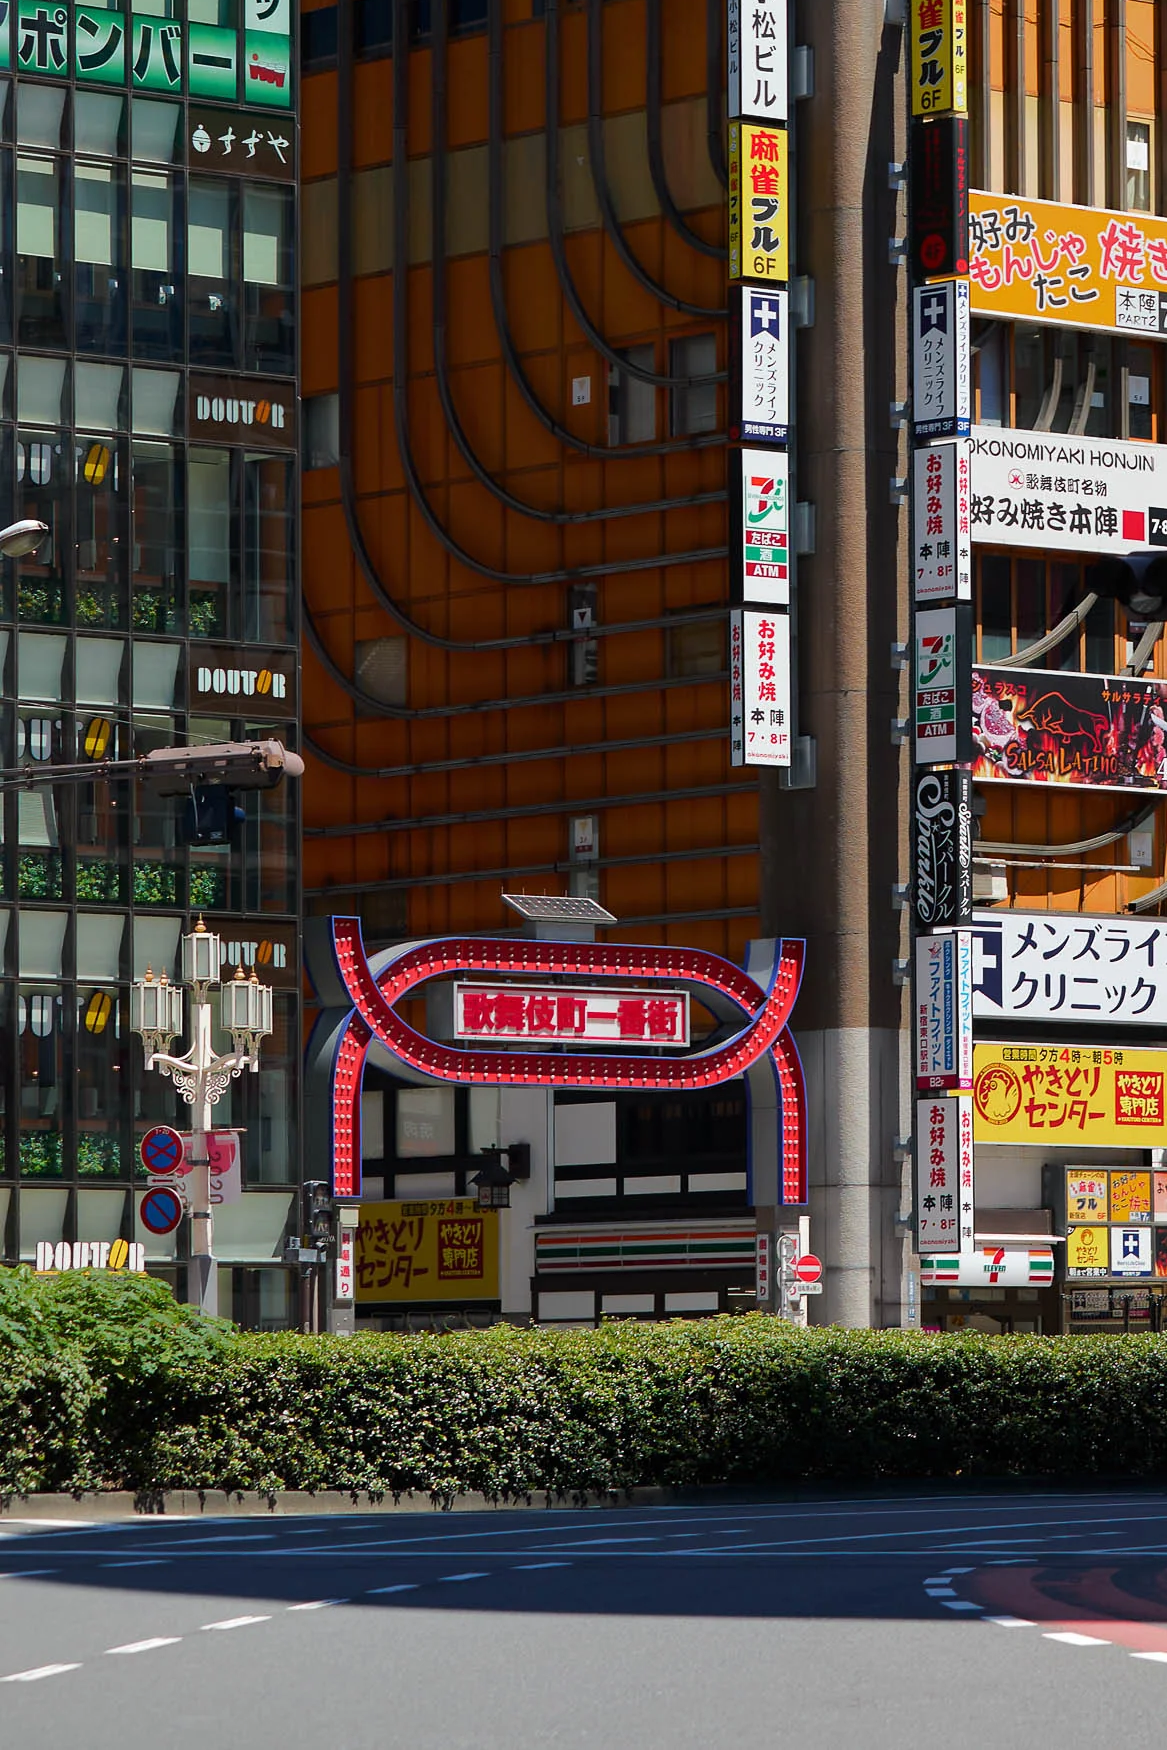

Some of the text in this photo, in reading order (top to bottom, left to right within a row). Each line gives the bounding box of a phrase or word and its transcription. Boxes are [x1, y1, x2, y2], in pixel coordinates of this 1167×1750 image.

[921, 89, 942, 110] 6F
[218, 126, 290, 164] すずや
[729, 158, 740, 225] 麻雀ブル
[749, 129, 781, 254] 麻雀ブル
[753, 255, 777, 276] 6F
[970, 231, 1087, 290] もんじゃ
[1032, 264, 1100, 311] たこ
[1119, 292, 1158, 313] 本陣
[1117, 312, 1158, 327] PART2
[753, 341, 765, 407] クリニック
[922, 338, 934, 406] クリニック
[958, 298, 968, 416] メンズライフクリニック
[766, 341, 778, 421] メンズライフ
[933, 336, 945, 418] メンズライフ
[197, 395, 286, 428] DOUTOR
[957, 421, 970, 432] 3F
[774, 426, 788, 439] 3F
[1090, 444, 1155, 472] HONJIN
[926, 453, 943, 536] お好み焼
[959, 456, 969, 534] お好み焼
[1025, 473, 1107, 497] 歌舞伎町名物
[751, 531, 782, 547] たばこ
[759, 549, 773, 563] 酒
[919, 541, 951, 561] 本陣
[753, 563, 779, 578] ATM
[959, 547, 969, 585] 本陣
[732, 624, 741, 703] お好み焼
[758, 619, 777, 703] お好み焼
[197, 666, 286, 699] DOUTOR
[922, 692, 949, 705] たばこ
[971, 680, 1027, 698] シュラスコ
[750, 708, 785, 728] 本陣
[924, 723, 948, 737] ATM
[929, 707, 942, 720] 酒
[733, 714, 741, 753] 本陣
[1006, 741, 1119, 776] SALSA LATINO
[916, 775, 955, 923] Sparkle
[958, 802, 971, 868] Sparkle
[936, 829, 955, 923] スパークル
[959, 869, 970, 917] スパークル
[959, 947, 971, 1035] ファイトフィット
[1011, 970, 1157, 1015] クリニック
[462, 992, 678, 1037] 歌舞伎町一番街
[929, 961, 942, 1072] ファイトフィット
[919, 1004, 929, 1073] 新宿東口駅前
[1021, 1064, 1101, 1098] やきとり
[1117, 1073, 1162, 1096] やきとり
[1024, 1096, 1106, 1130] センター
[1119, 1096, 1159, 1118] 専門店
[928, 1104, 947, 1188] お好み焼
[961, 1109, 972, 1189] お好み焼
[1078, 1180, 1096, 1194] 麻雀
[1112, 1172, 1137, 1189] お好み
[1112, 1181, 1146, 1201] もんじゃ
[923, 1194, 954, 1214] 本陣
[962, 1200, 973, 1241] 本陣
[1076, 1197, 1098, 1211] ブル
[1111, 1198, 1129, 1213] たこ
[1129, 1196, 1150, 1211] 焼き
[355, 1217, 424, 1253] やきとり
[439, 1222, 481, 1246] やきとり
[1075, 1246, 1098, 1255] やきとり
[36, 1238, 146, 1272] DOUTOR
[356, 1255, 428, 1289] センター
[983, 1264, 1007, 1273] ELEVEN
[1076, 1255, 1099, 1265] センター
